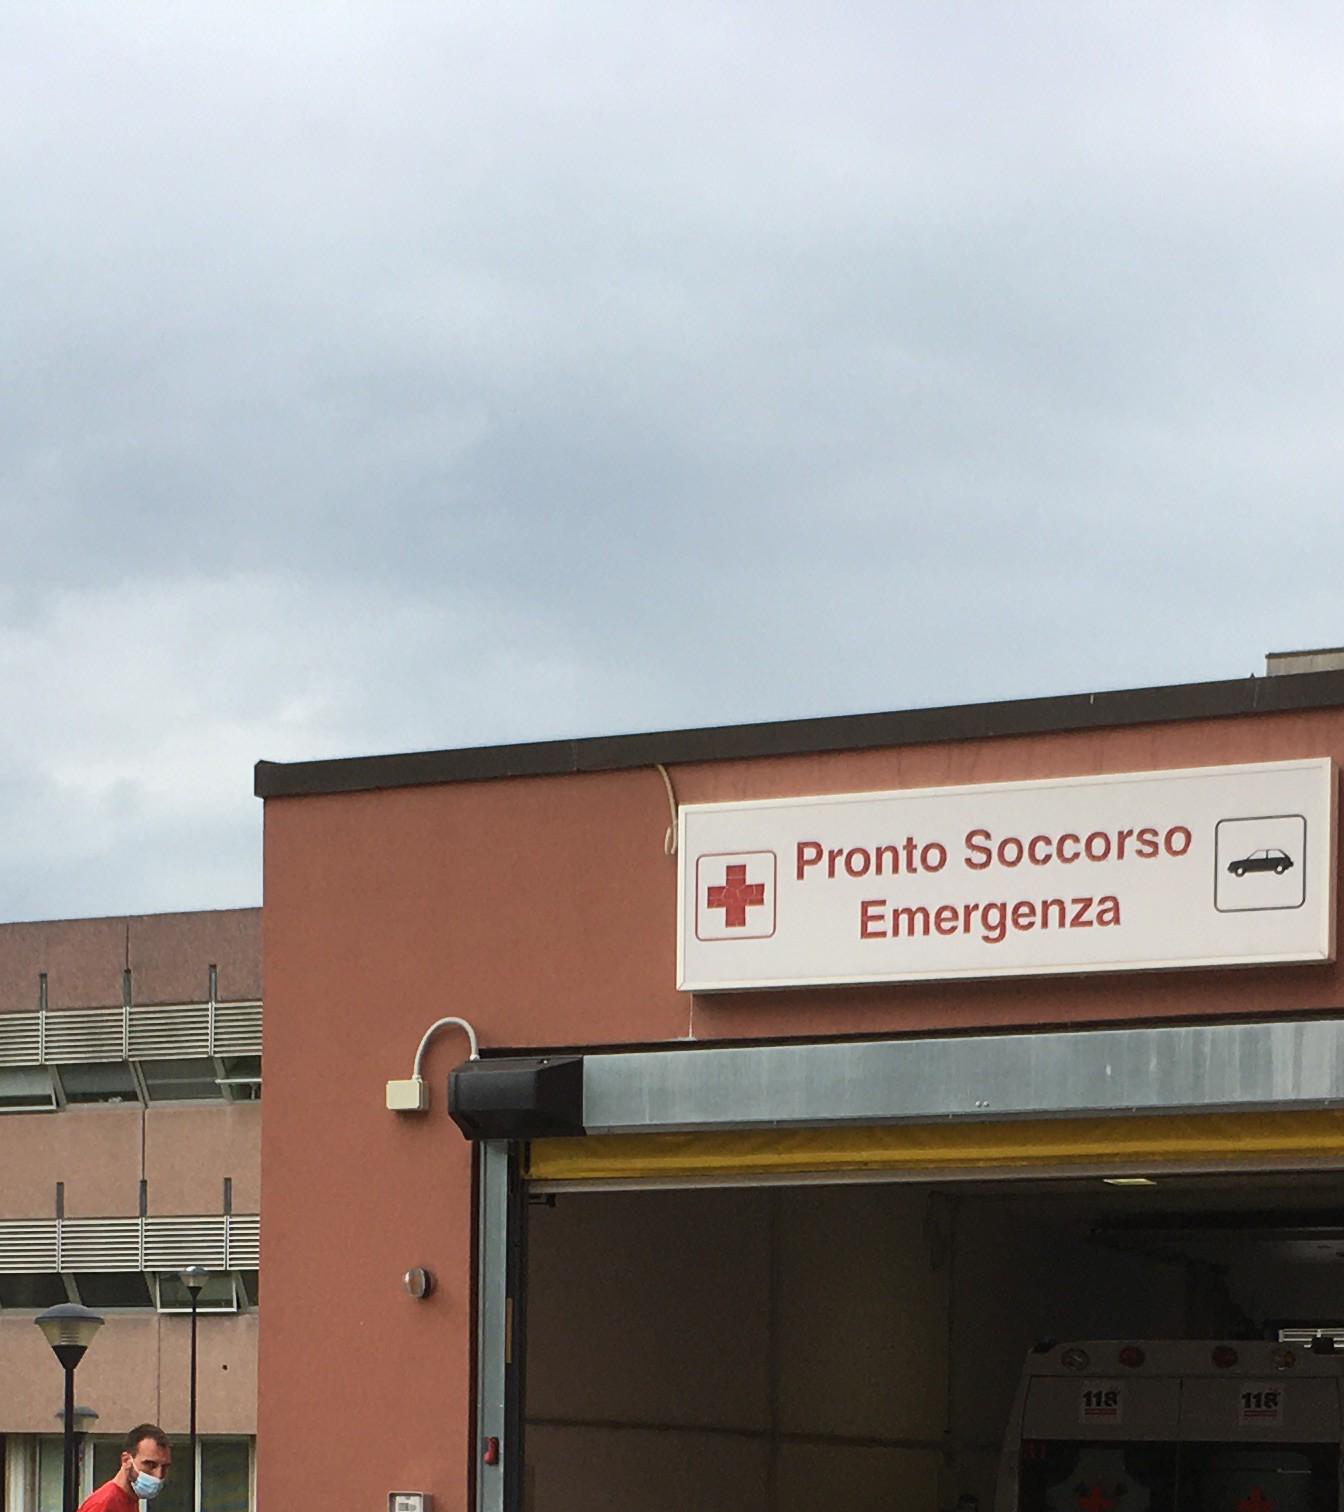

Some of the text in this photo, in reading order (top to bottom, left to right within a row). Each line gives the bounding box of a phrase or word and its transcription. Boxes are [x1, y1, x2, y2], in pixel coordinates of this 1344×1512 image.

[796, 825, 1193, 881] Pronto Soccorso
[860, 894, 1122, 945] Emergenza
[1082, 1388, 1119, 1408] 118
[1241, 1389, 1281, 1409] 118
